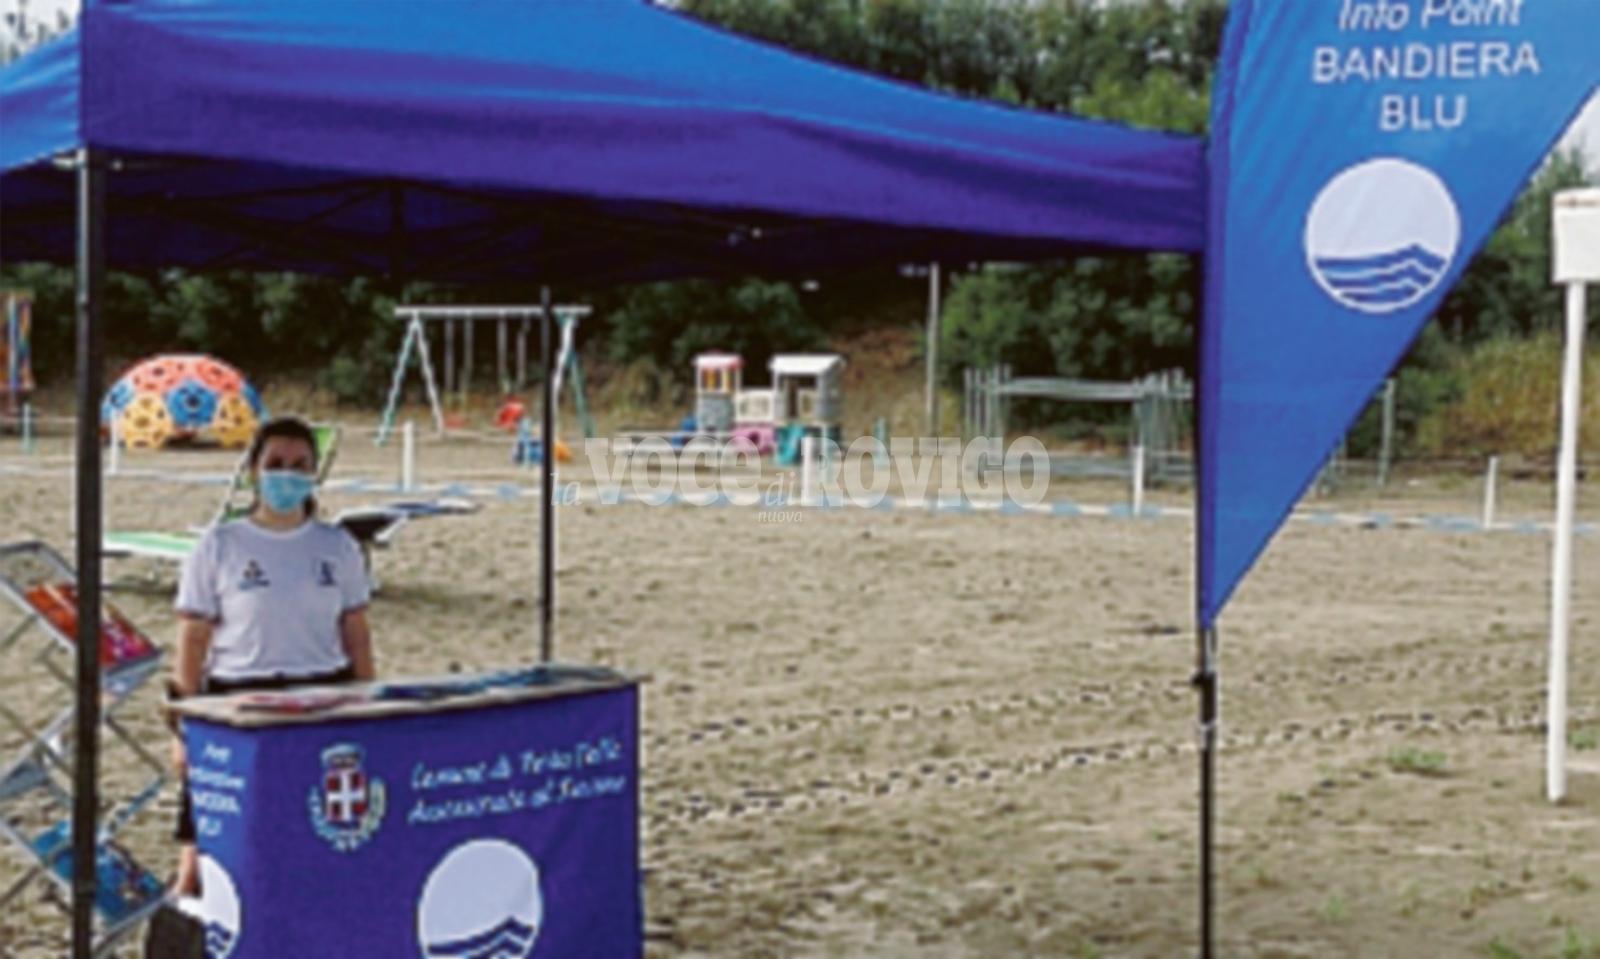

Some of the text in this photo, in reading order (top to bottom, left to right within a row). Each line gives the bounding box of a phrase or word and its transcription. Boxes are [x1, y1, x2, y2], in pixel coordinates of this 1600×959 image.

[1421, 0, 1526, 28] Point
[1313, 42, 1540, 83] BANDIERA
[1379, 94, 1467, 131] BLU
